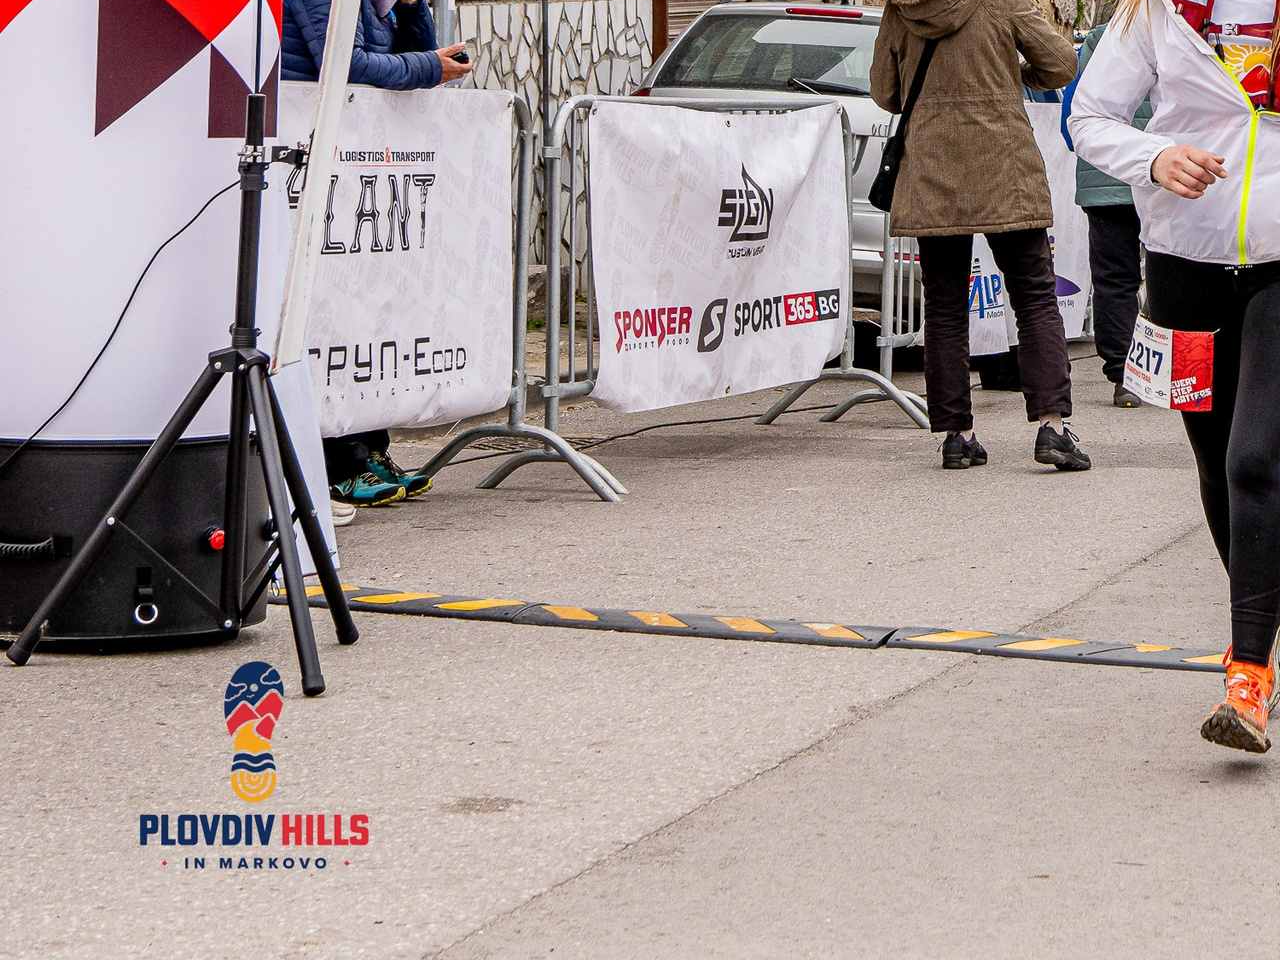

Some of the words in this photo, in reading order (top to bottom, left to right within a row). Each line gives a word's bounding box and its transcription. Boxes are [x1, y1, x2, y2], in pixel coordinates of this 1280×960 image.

[320, 173, 436, 254] LANT
[987, 311, 1004, 319] Made
[614, 306, 692, 354] SPONSER
[629, 341, 654, 350] SPORT
[666, 338, 690, 346] FOOD
[1128, 337, 1163, 376] 2217
[1171, 376, 1197, 389] EVERY
[1171, 386, 1193, 398] STEP
[1173, 387, 1212, 405] MATTERS
